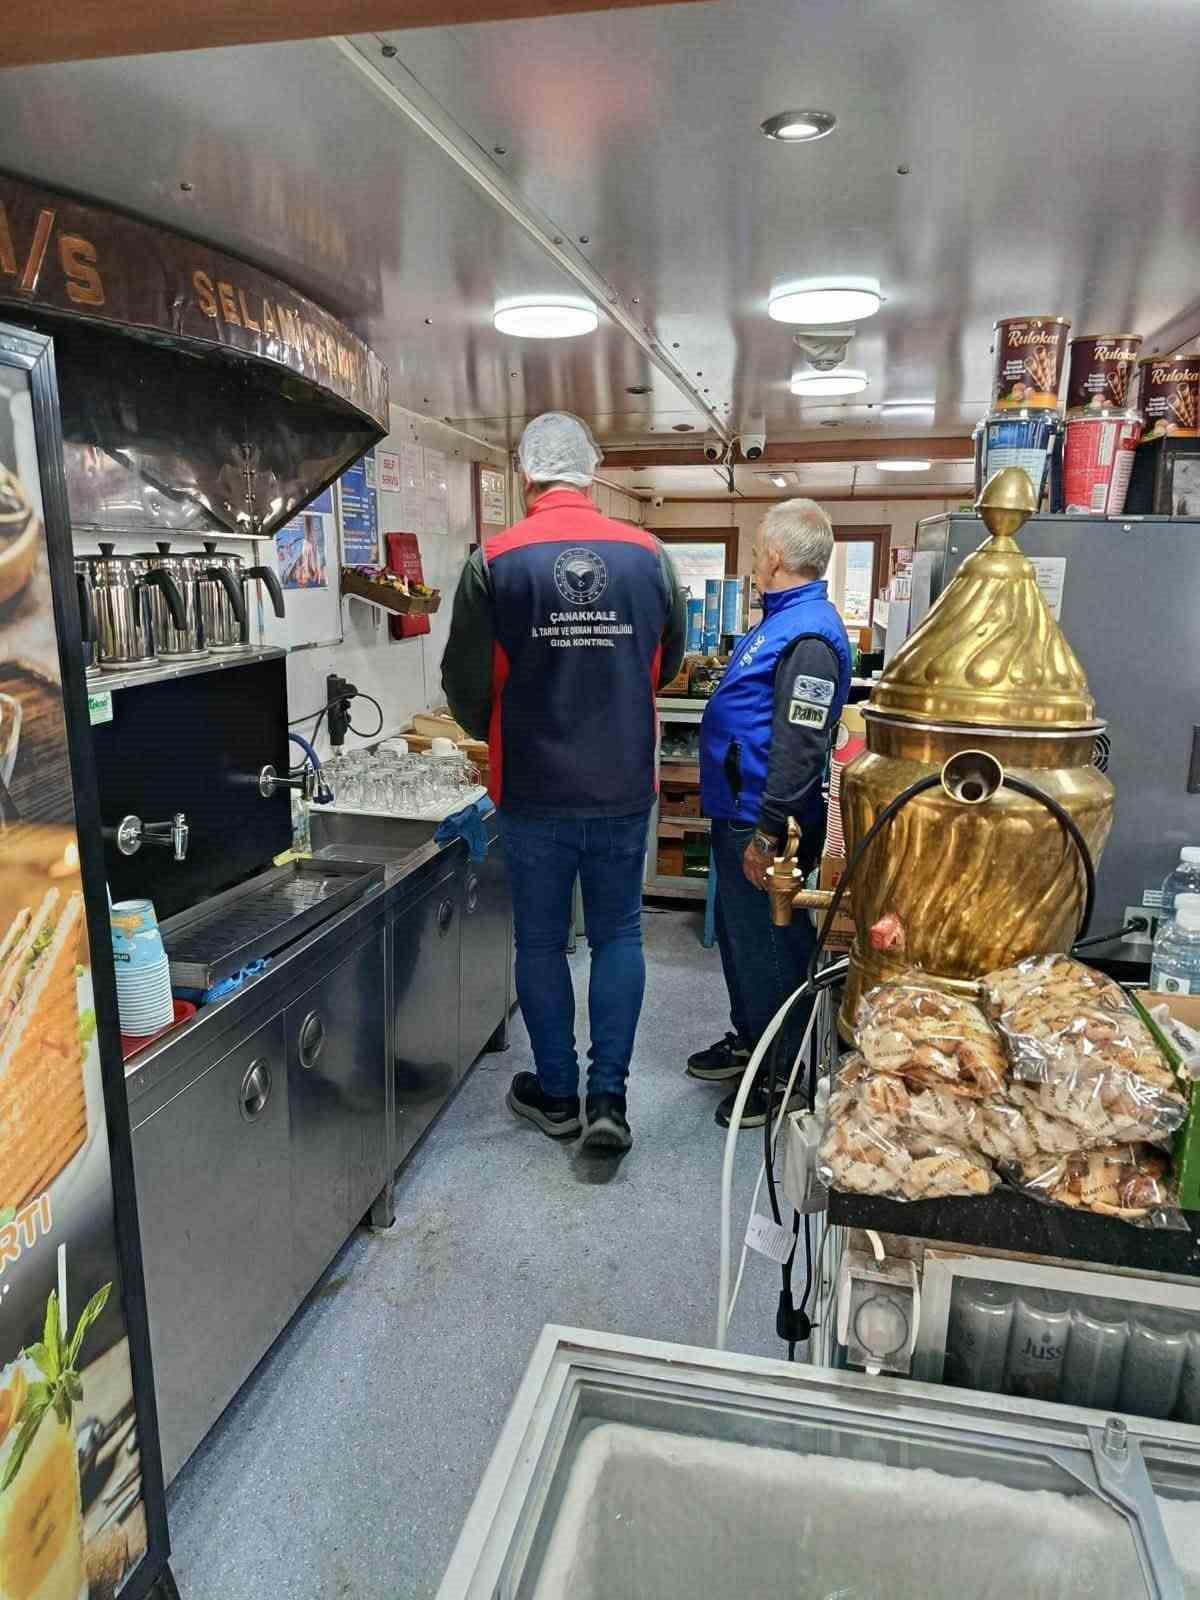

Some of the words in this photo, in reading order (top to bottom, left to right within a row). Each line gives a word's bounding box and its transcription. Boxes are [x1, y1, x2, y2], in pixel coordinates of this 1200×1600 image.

[550, 611, 617, 624] ÇANAKKALE
[539, 627, 560, 637] TARIM
[560, 626, 569, 636] VE
[570, 625, 592, 635] ORMAN
[550, 639, 571, 648] GIDA
[572, 638, 615, 648] KONTROL
